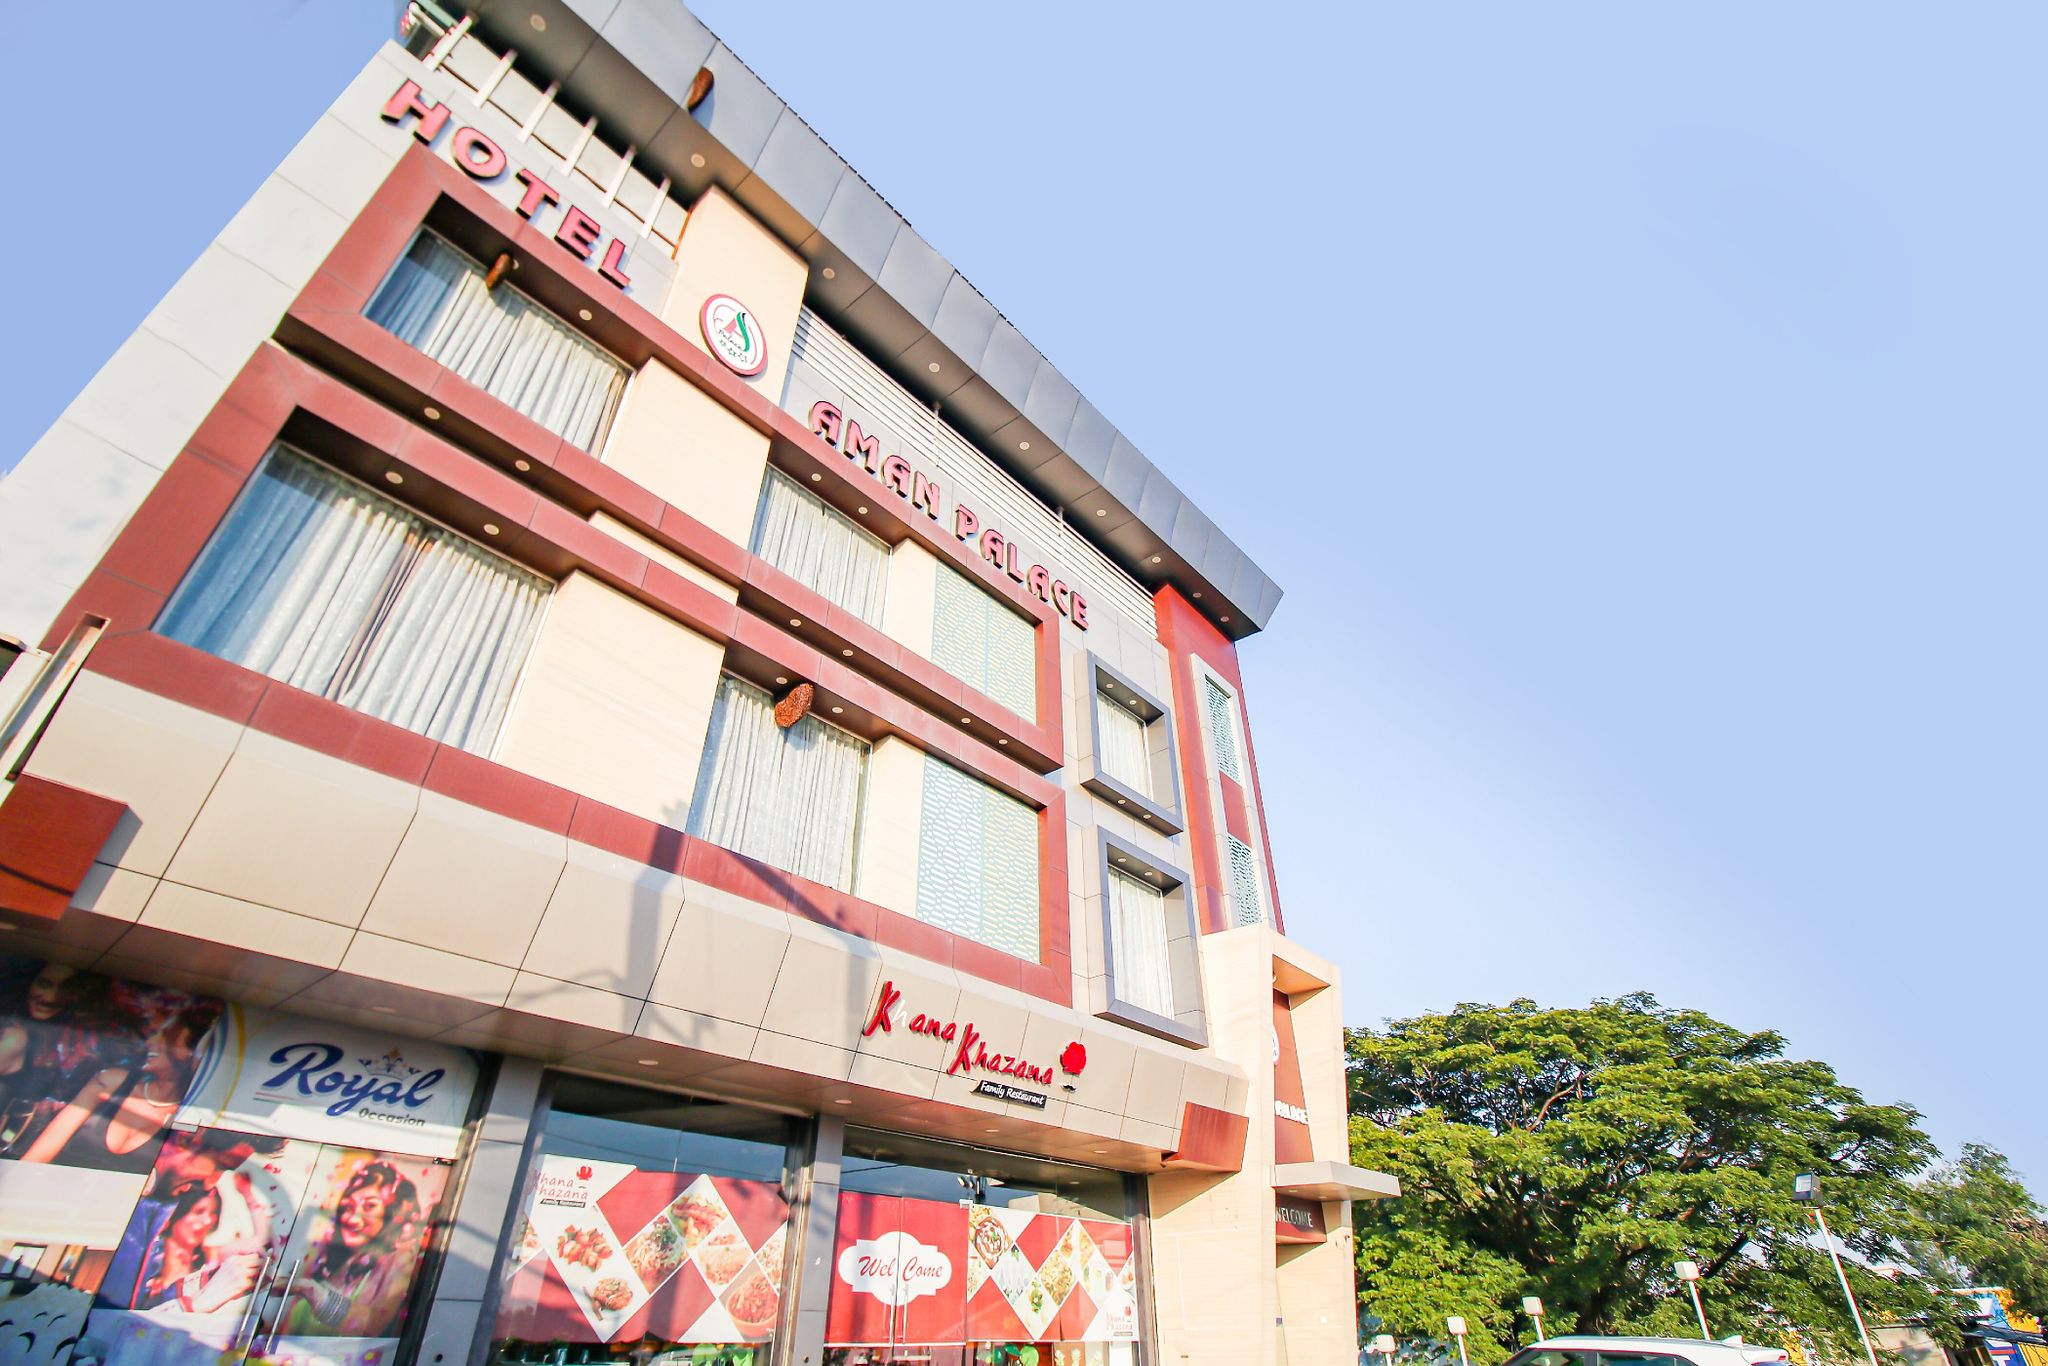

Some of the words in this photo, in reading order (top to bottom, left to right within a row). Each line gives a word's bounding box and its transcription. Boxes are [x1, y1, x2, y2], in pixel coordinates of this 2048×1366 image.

[381, 78, 631, 290] HOTEL
[809, 401, 940, 520] AMAN
[955, 504, 1089, 631] PALACE
[863, 981, 956, 1041] Khana
[947, 1023, 1053, 1085] Khazana
[262, 1043, 446, 1117] Royal
[980, 1082, 1005, 1098] Family
[1006, 1088, 1045, 1105] Restaurant
[359, 1108, 425, 1127] Occasion
[1275, 1207, 1314, 1228] WELCOME
[858, 1256, 896, 1276] Wel
[902, 1257, 942, 1281] Come
